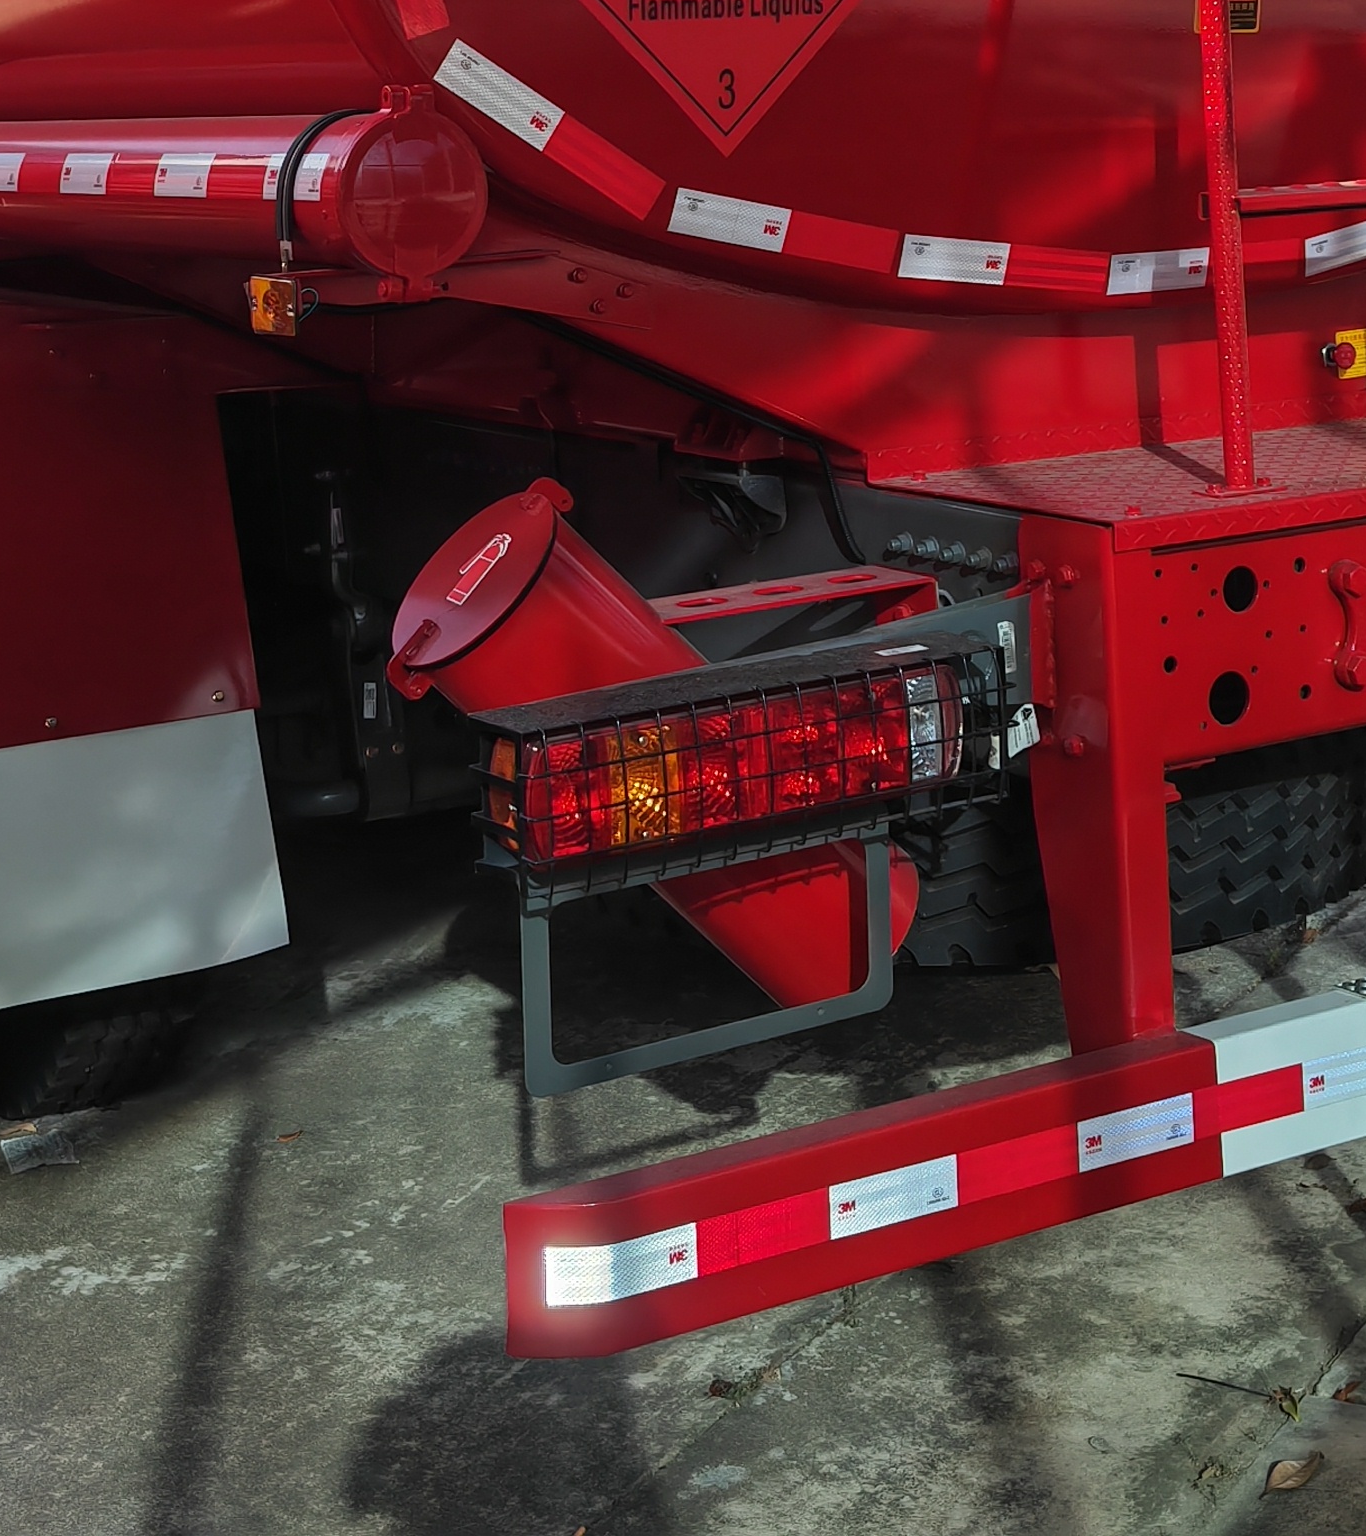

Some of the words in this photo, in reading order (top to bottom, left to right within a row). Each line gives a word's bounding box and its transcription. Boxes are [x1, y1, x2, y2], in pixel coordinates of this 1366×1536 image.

[718, 69, 735, 109] 3
[530, 115, 548, 132] 3M
[764, 224, 781, 236] 3M
[986, 260, 1001, 270] 3M
[1310, 1075, 1325, 1088] 3M
[1085, 1135, 1102, 1149] 3M
[838, 1200, 856, 1214] 3M
[670, 1249, 688, 1264] 3M
